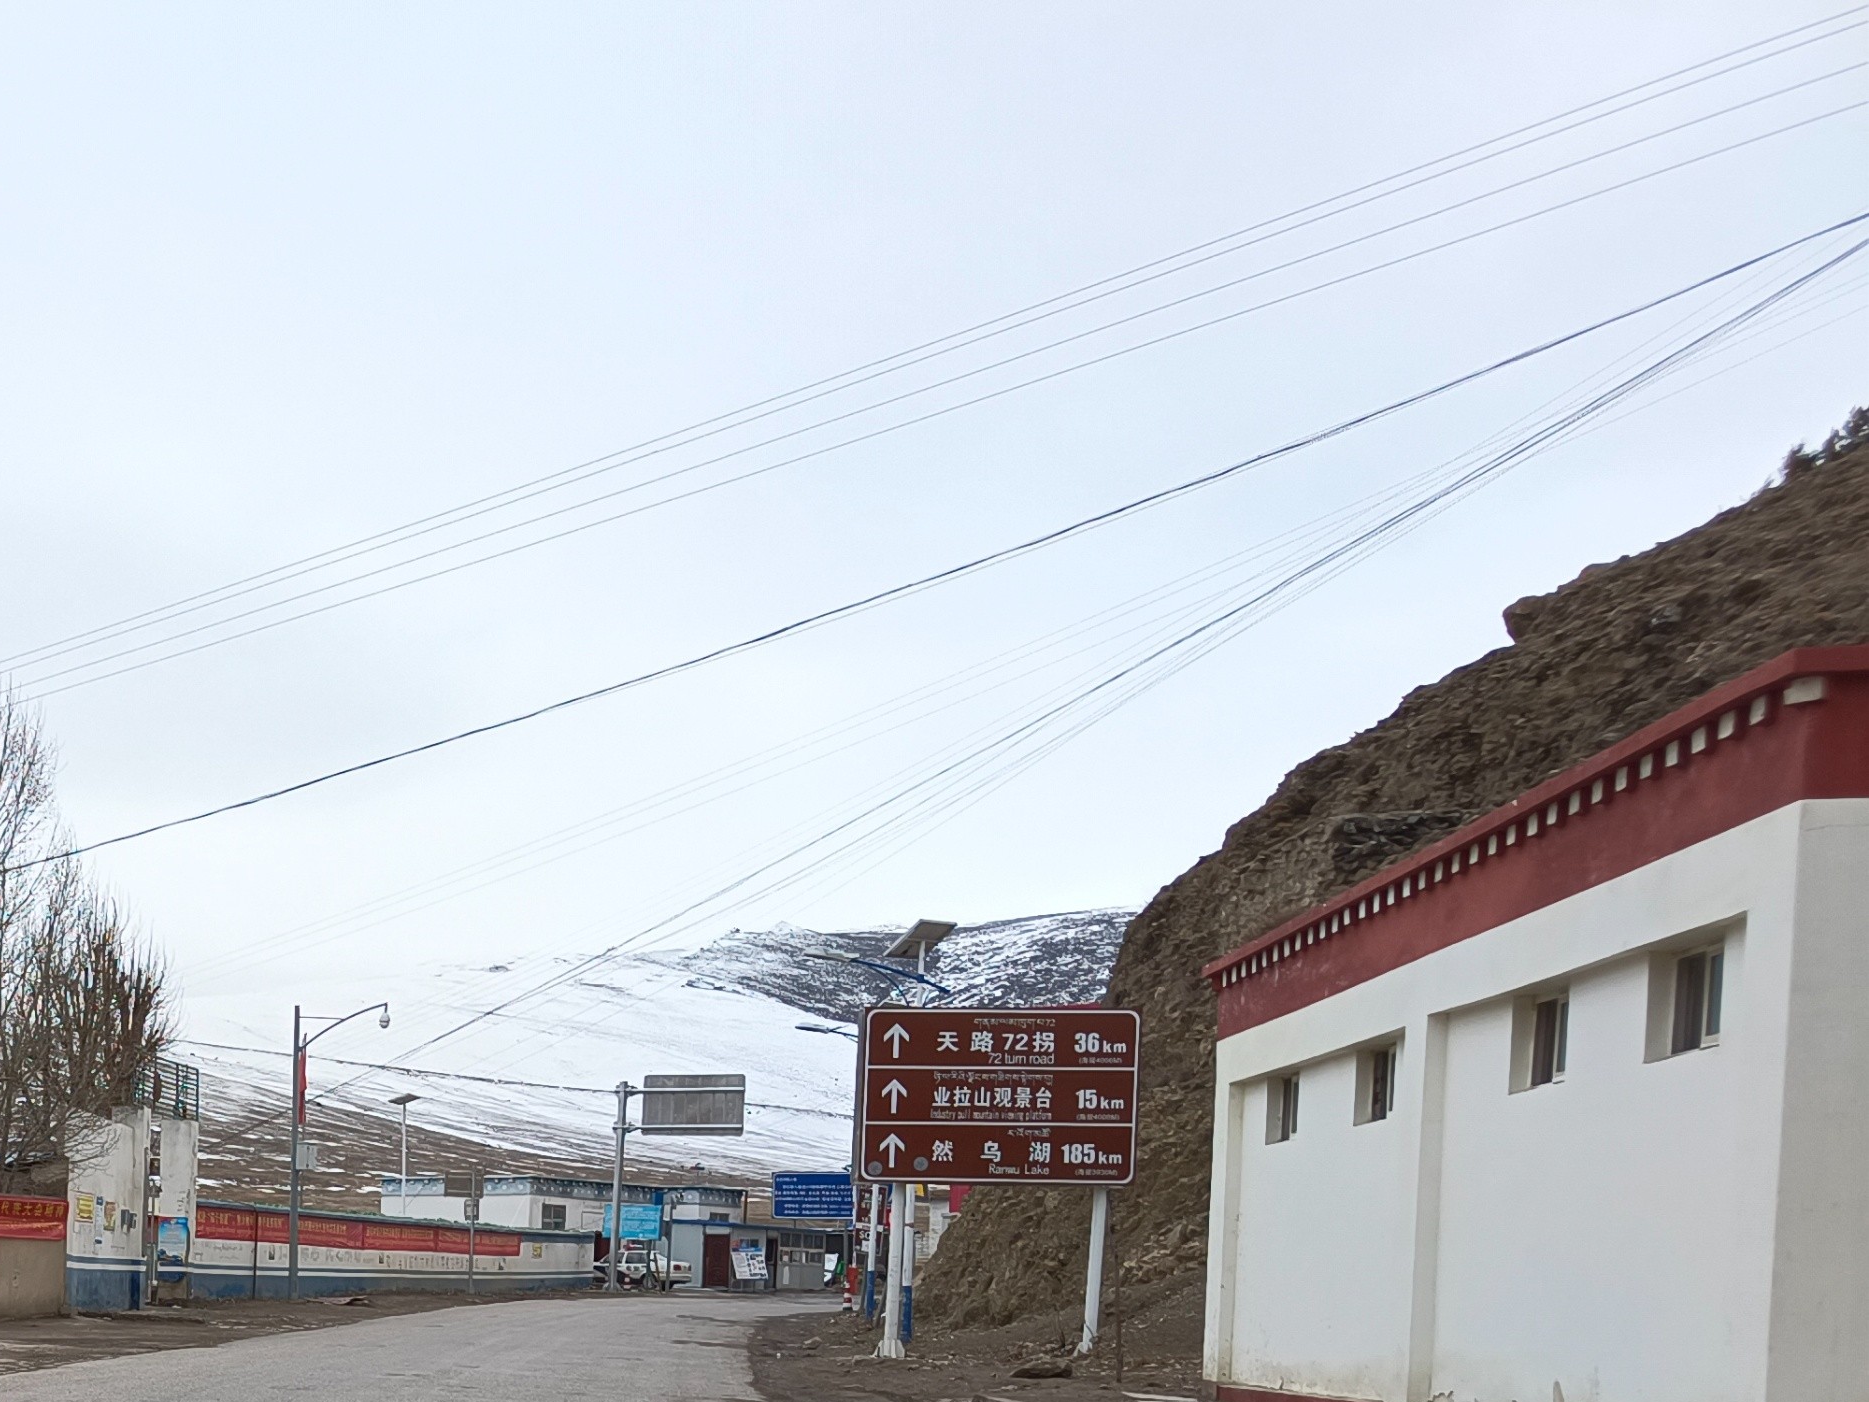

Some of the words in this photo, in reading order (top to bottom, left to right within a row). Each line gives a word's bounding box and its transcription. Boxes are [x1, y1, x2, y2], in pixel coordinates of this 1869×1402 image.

[937, 1031, 1055, 1052] 天路72拐
[988, 1053, 1001, 1064] 72
[1029, 1053, 1054, 1064] road
[932, 1086, 1052, 1109] 业拉山观景台
[932, 1140, 1051, 1162] 然乌湖
[988, 1164, 1020, 1175] Ranwu
[1025, 1164, 1049, 1175] Lake
